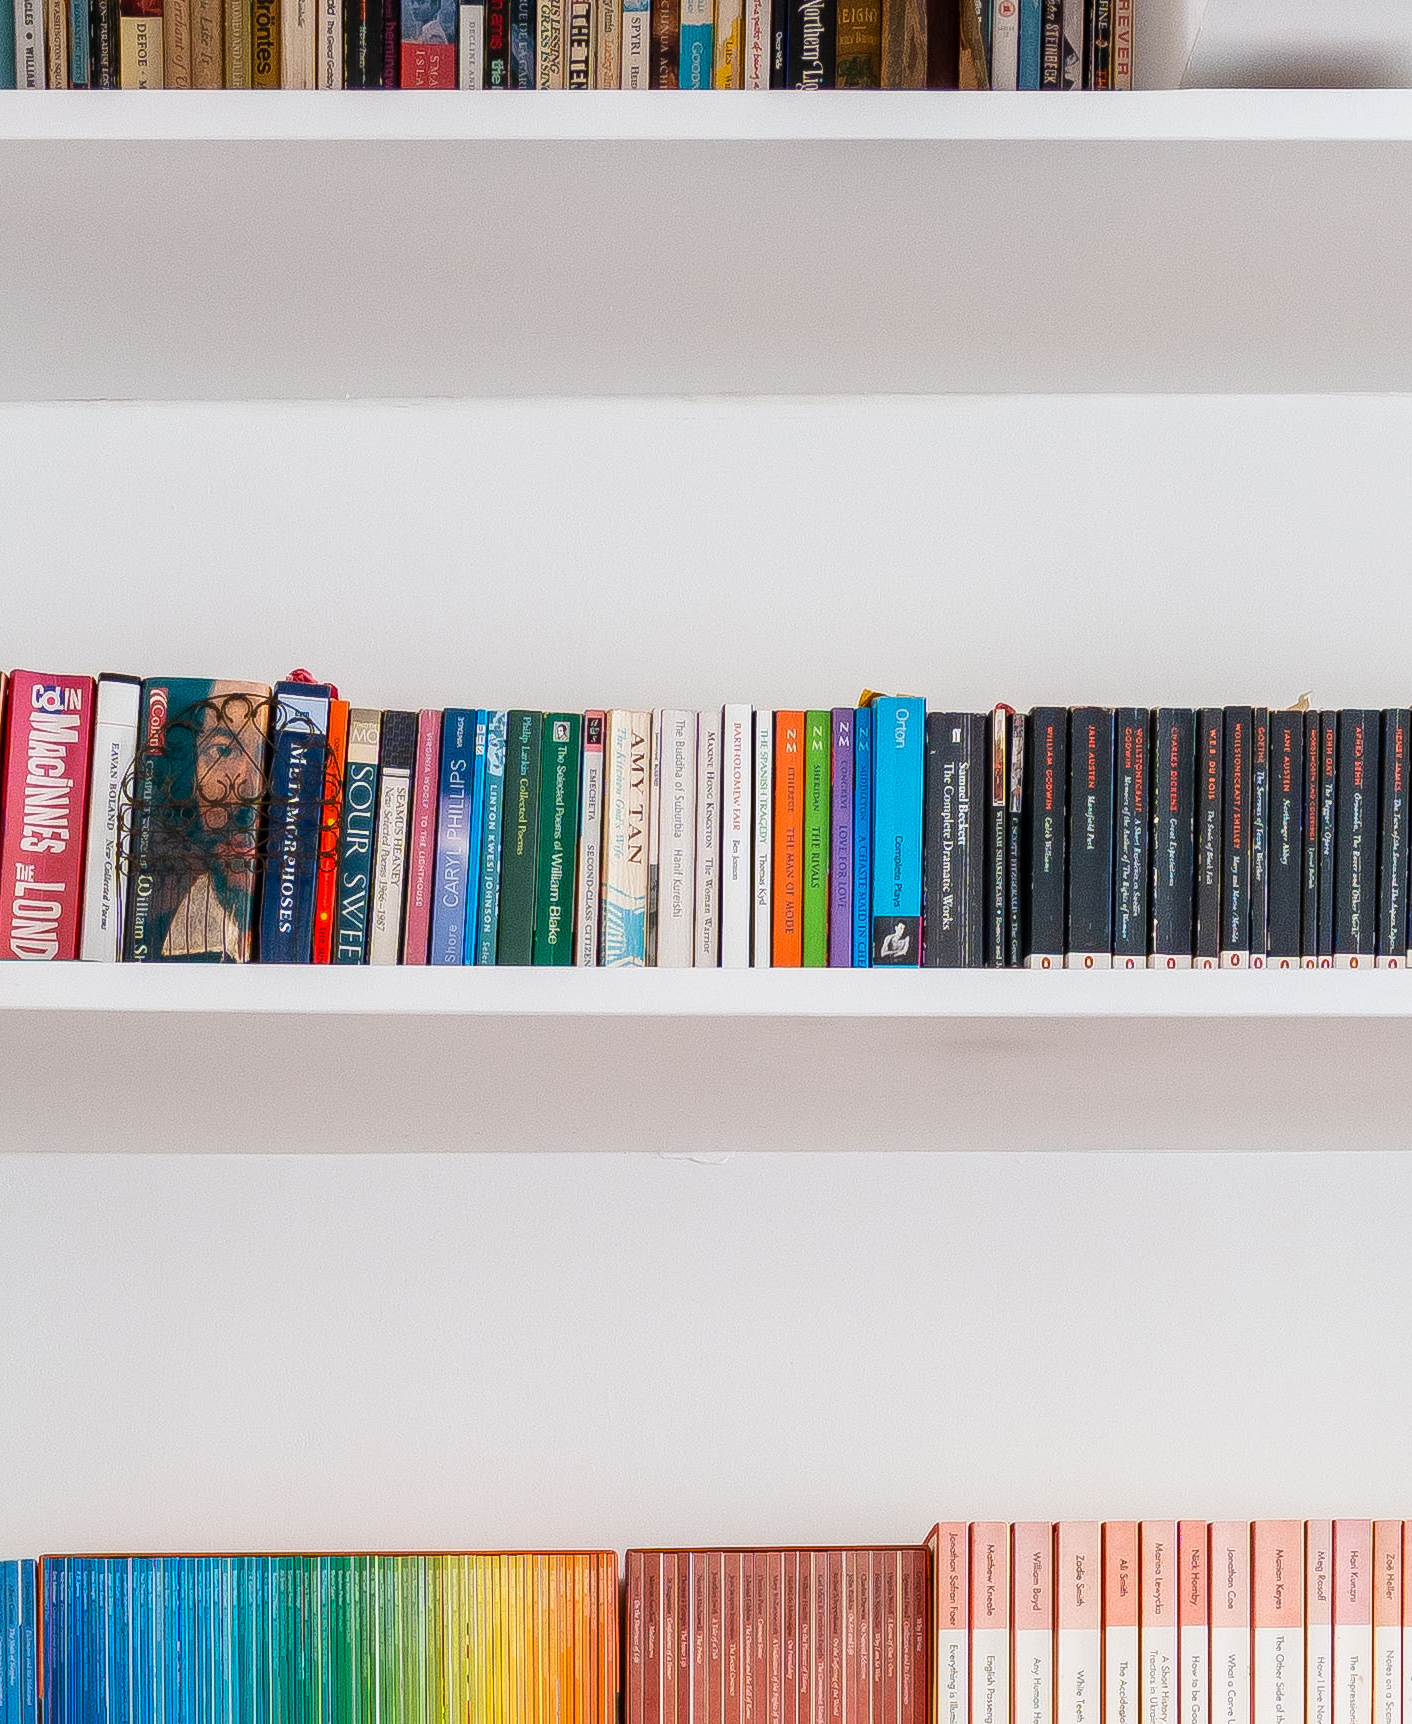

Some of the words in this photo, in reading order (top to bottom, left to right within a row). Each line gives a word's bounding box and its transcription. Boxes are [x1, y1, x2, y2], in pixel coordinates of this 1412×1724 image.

[136, 23, 147, 67] DEFOE
[631, 17, 641, 55] SPYRI
[1044, 24, 1058, 83] STEINBECK
[895, 708, 908, 748] Orton
[630, 731, 645, 795] AMY
[944, 762, 954, 782] The
[958, 762, 969, 801] Samuel
[445, 759, 467, 840] PHILLIPS
[941, 785, 953, 838] Complete
[627, 804, 644, 865] TAN
[957, 804, 968, 845] Beckett
[443, 845, 466, 907] CARYL
[549, 853, 565, 901] William
[942, 841, 953, 892] Dramatic
[547, 905, 563, 944] Blake
[942, 895, 952, 930] Works
[986, 1656, 995, 1685] English
